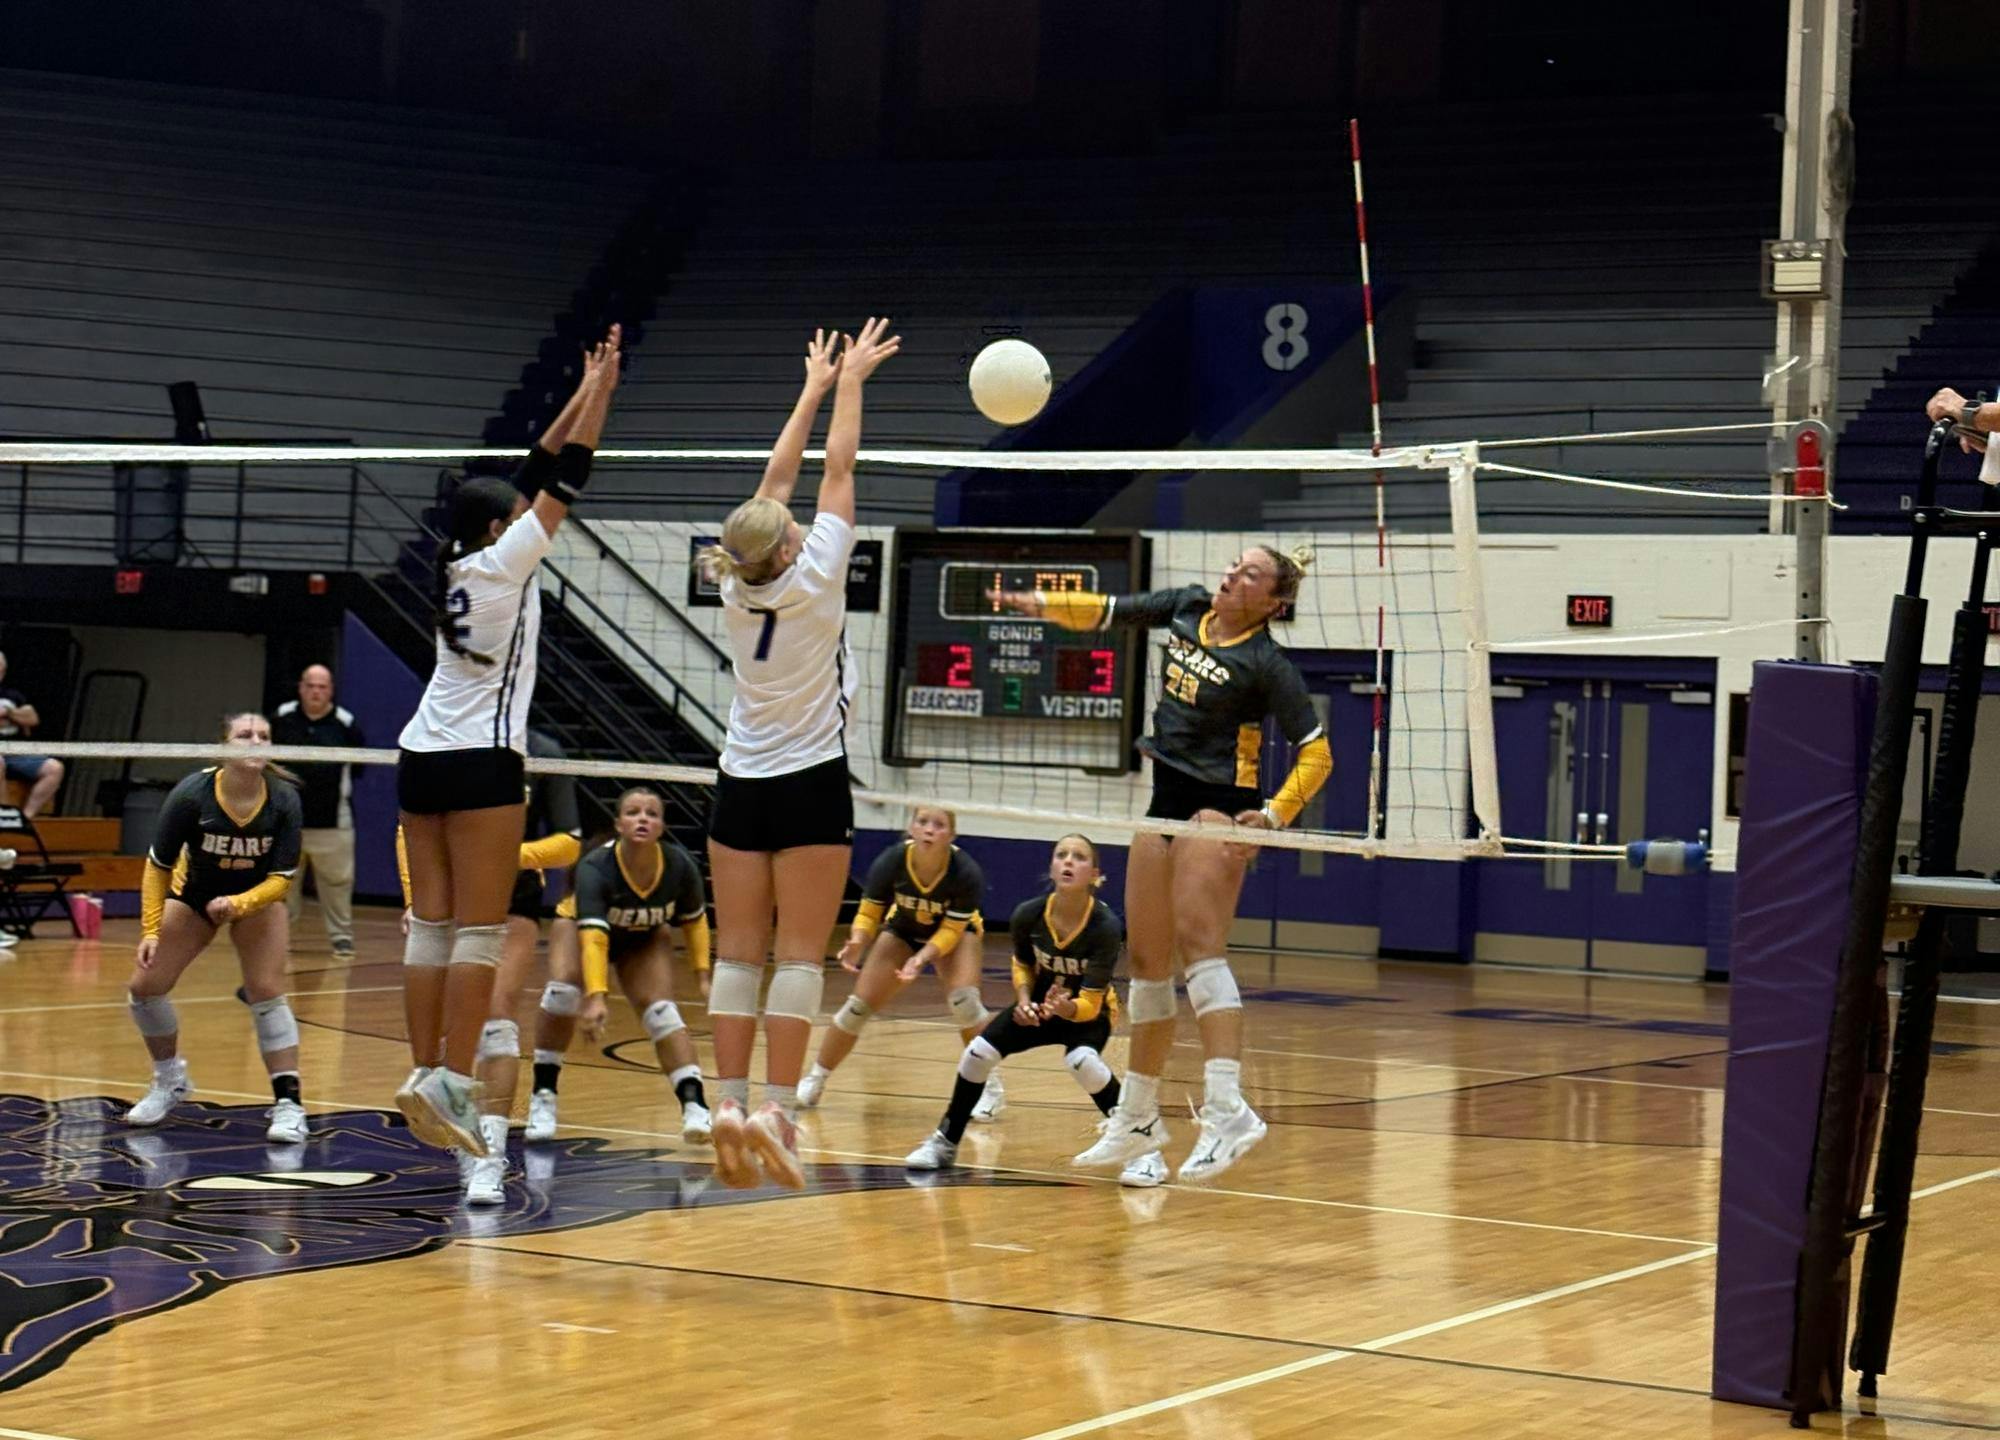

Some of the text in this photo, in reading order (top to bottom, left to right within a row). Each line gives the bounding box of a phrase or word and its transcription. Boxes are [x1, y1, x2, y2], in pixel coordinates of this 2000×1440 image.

[1262, 303, 1309, 371] 8
[1900, 495, 1911, 510] D
[1574, 599, 1605, 622] EXIT
[749, 607, 777, 661] 7
[988, 625, 1044, 642] BONUS
[948, 645, 972, 688] 2
[989, 659, 1042, 674] PERIOD
[1089, 649, 1116, 693] 3
[911, 690, 979, 711] BEARCATS
[1041, 695, 1124, 718] VISITOR
